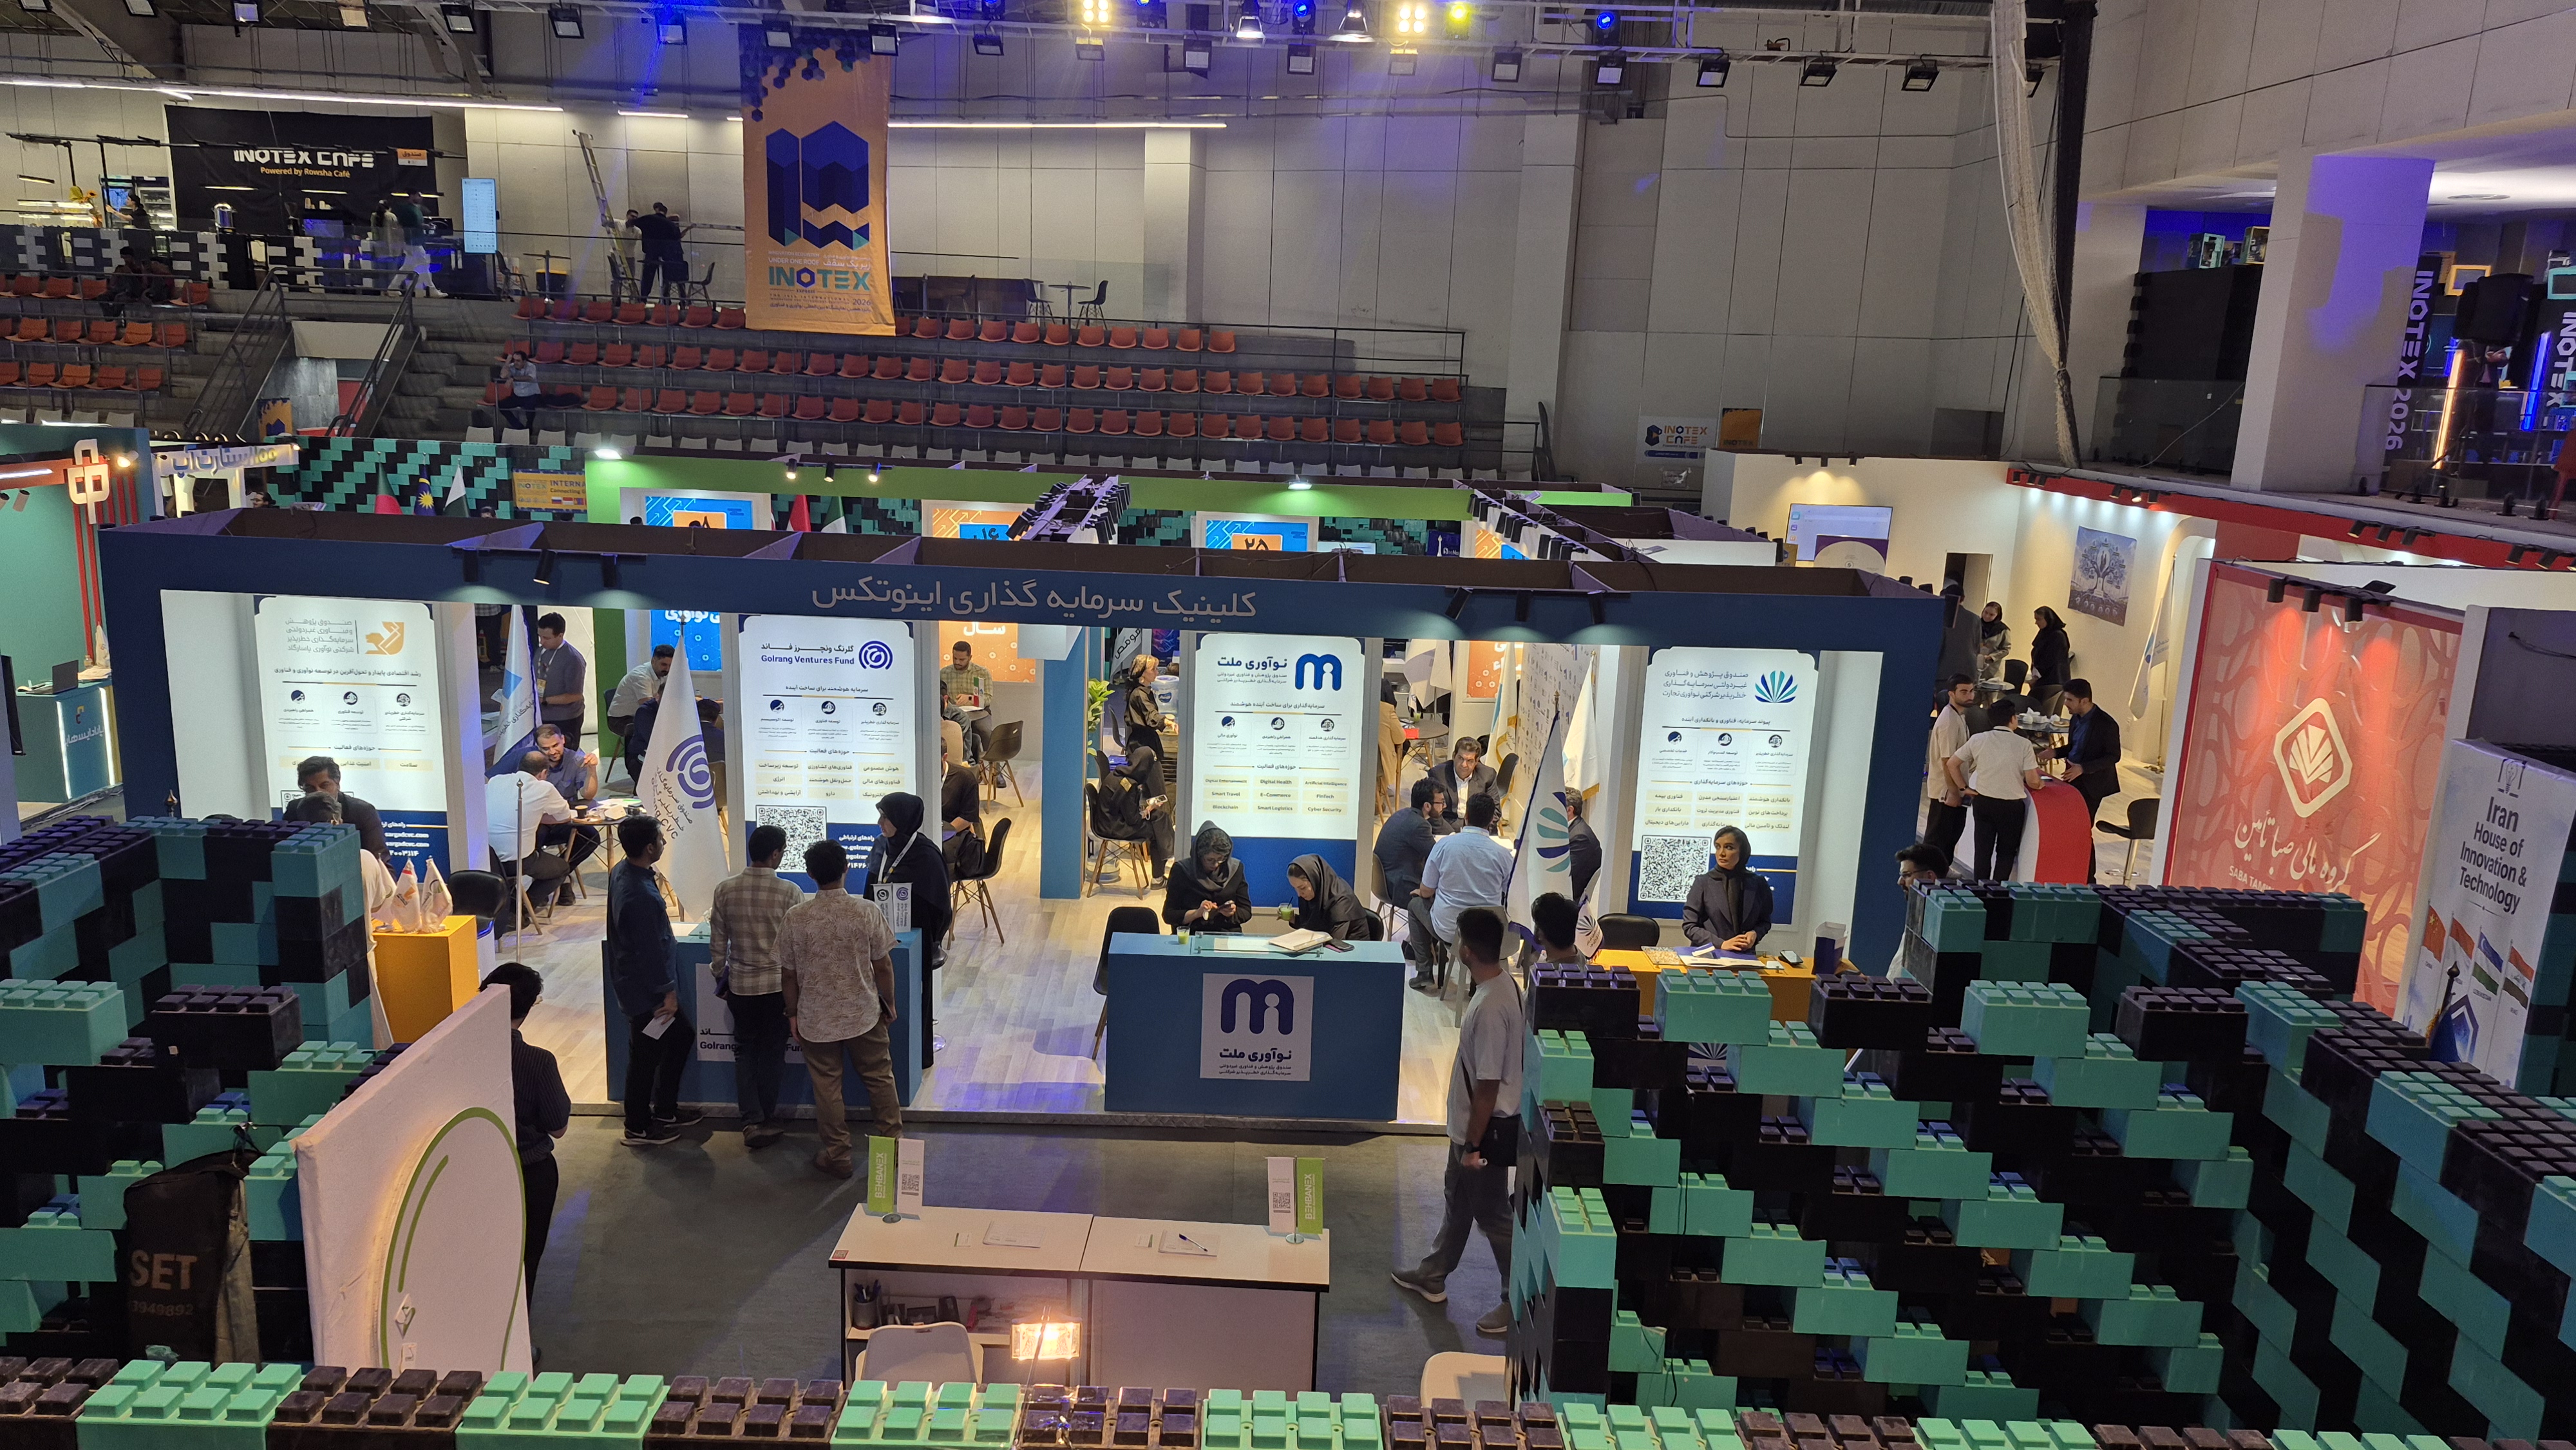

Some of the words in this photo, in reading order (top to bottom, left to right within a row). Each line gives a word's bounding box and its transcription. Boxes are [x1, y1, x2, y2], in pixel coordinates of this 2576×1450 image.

[233, 149, 312, 164] INOTEX
[317, 151, 374, 168] CAFE
[294, 168, 303, 176] by
[304, 168, 333, 177] Rowsha
[334, 169, 350, 178] Café
[846, 260, 858, 269] یک
[769, 266, 870, 291] INOTEX
[2398, 270, 2434, 379] INOTEX
[2385, 388, 2411, 451] 2026
[1664, 426, 1708, 435] INOTEX
[1666, 436, 1698, 444] CAFE
[811, 576, 942, 612] اینوتکس
[948, 579, 1037, 615] گذاری
[1046, 586, 1144, 619] سرمایه
[1152, 587, 1256, 623] کلینیک
[285, 617, 316, 626] پژوهش
[288, 645, 311, 653] پاسارگاد
[314, 645, 331, 653] نوآوری
[794, 645, 832, 654] ونچرز
[761, 655, 793, 664] Golrang
[795, 655, 833, 664] Ventures
[1217, 657, 1242, 666] ملت
[1245, 656, 1287, 671] نوآوری
[1665, 669, 1689, 677] فناوری
[1694, 671, 1723, 681] پژوهش
[1680, 689, 1700, 699] نوآوری
[2485, 796, 2519, 833] Iran
[661, 818, 678, 839] CVC
[2473, 821, 2507, 853] House
[2510, 838, 2525, 858] of
[2269, 826, 2295, 875] صبا
[2289, 837, 2317, 880] مالی
[2459, 840, 2517, 882] Innovation
[2517, 868, 2527, 887] &
[2229, 865, 2248, 885] SABA
[2459, 865, 2521, 916] Technology
[700, 1041, 737, 1051] Golrang
[786, 1044, 803, 1052] Fun
[1219, 1048, 1245, 1059] ملت
[1248, 1048, 1292, 1063] نوآوری
[875, 1153, 884, 1198] BEHBANEX
[1304, 1174, 1312, 1219] BEHBANEX
[129, 1249, 197, 1290] SET
